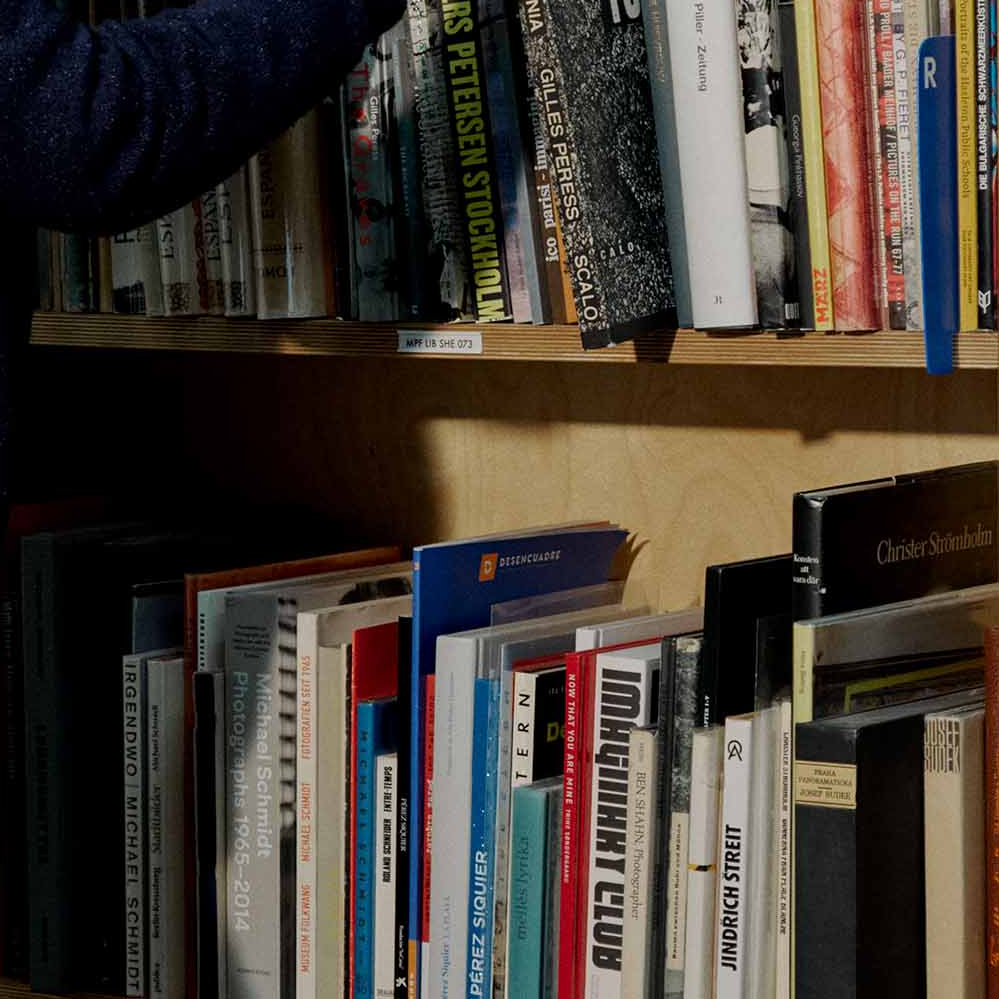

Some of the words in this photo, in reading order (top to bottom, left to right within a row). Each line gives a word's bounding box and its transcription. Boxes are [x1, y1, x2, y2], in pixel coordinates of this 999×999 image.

[694, 3, 705, 33] Piller
[879, 12, 891, 40] PROLL
[895, 24, 906, 43] BY
[696, 44, 711, 93] Zeitung
[896, 50, 906, 67] G.
[960, 43, 970, 56] of
[960, 58, 970, 73] the
[880, 51, 893, 87] BAADER
[923, 56, 938, 88] R
[350, 66, 371, 120] The
[369, 96, 380, 126] Gilles
[447, 41, 488, 167] PETERSEN
[540, 67, 565, 137] GILLES
[884, 89, 896, 133] MEINHOF
[960, 125, 972, 157] Public
[977, 104, 988, 172] BULGARISCHE
[551, 142, 581, 221] PERESS
[886, 142, 898, 188] PICTURES
[960, 159, 972, 199] Schools
[978, 173, 988, 190] DIE
[353, 135, 375, 247] Graves
[537, 183, 556, 229] parisi
[889, 206, 899, 224] THE
[462, 171, 504, 321] STOCKHOLM
[545, 237, 559, 262] ico
[890, 226, 901, 246] RUN
[574, 254, 599, 321] SCALO
[406, 338, 423, 348] MPF
[425, 338, 437, 348] LIB
[440, 339, 455, 348] SHE
[457, 339, 473, 349] 073
[499, 548, 562, 568] DESENCUADRE
[877, 537, 929, 567] Christer
[928, 524, 993, 556] Strömholm
[483, 559, 494, 576] D
[302, 655, 311, 677] 1965
[302, 678, 312, 698] SEIT
[568, 673, 577, 699] NOW
[124, 663, 138, 778] IRGENDWO
[255, 672, 273, 762] Michael
[302, 700, 312, 760] FOTOGRAFIEN
[566, 701, 576, 727] THAT
[924, 718, 960, 747] JOSEF
[229, 670, 250, 808] Photographs
[566, 729, 575, 751] YOU
[566, 753, 575, 775] ARE
[592, 668, 641, 876] IMAGINARY
[813, 768, 837, 778] PRAHA
[924, 745, 961, 774] SUDEK
[357, 729, 369, 832] MICHAEL
[383, 765, 393, 813] ENTRE-TEMPS
[565, 777, 575, 805] MINE
[635, 771, 648, 798] BEN
[800, 789, 823, 798] JOSEF
[255, 766, 273, 858] Schmidt
[301, 781, 311, 819] SCHMIDT
[125, 796, 139, 886] MICHAEL
[301, 821, 311, 863] MICHAEL
[382, 818, 393, 854] SCHNEIDER
[382, 854, 392, 883] ROLAND
[630, 848, 645, 921] Photographer
[300, 883, 311, 933] FOLKWANG
[357, 843, 369, 943] SCHMIDT
[472, 851, 489, 929] SIQUIER
[125, 896, 140, 991] SCHMIDT
[592, 881, 623, 972] CLUB
[720, 885, 740, 972] JINDŘICH
[300, 935, 310, 973] MUSEUM
[467, 934, 485, 998] PÉREZ
